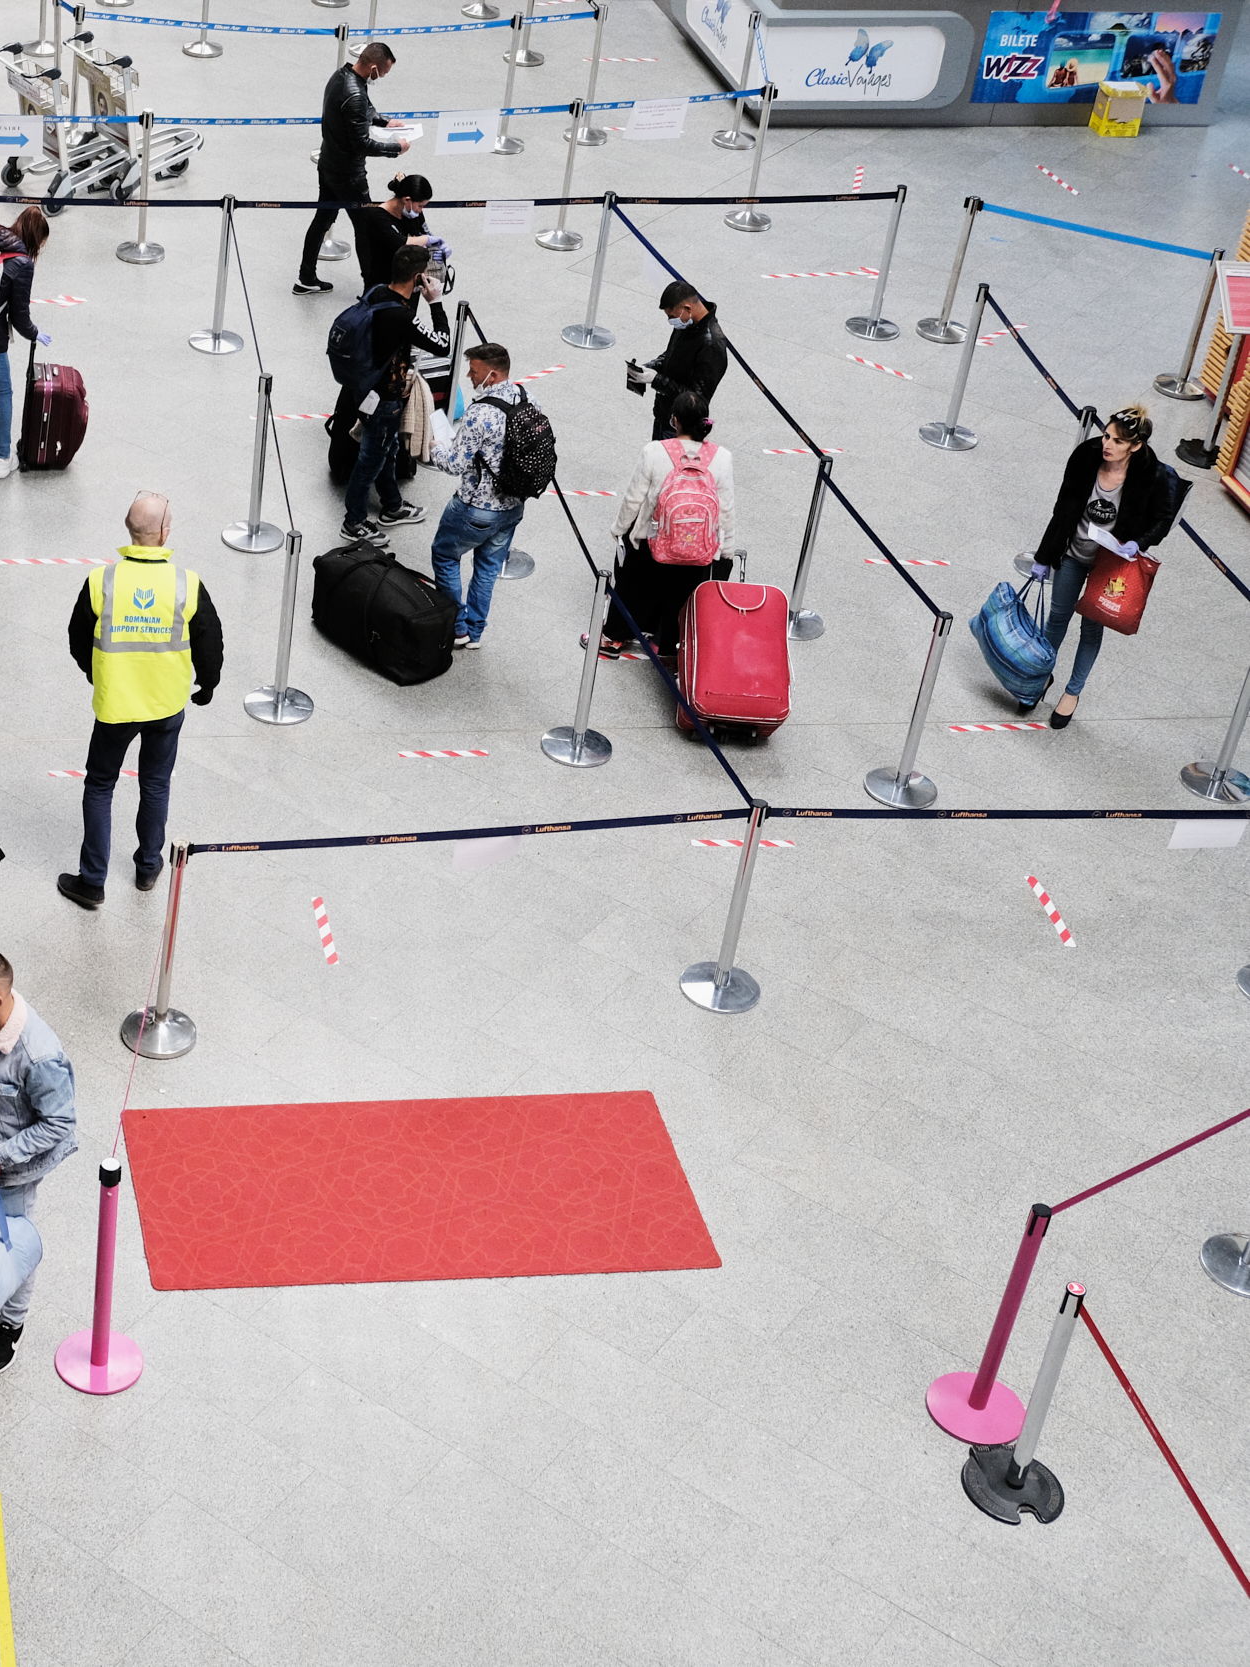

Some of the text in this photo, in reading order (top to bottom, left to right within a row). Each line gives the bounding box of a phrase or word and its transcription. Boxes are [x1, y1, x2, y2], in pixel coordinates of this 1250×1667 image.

[1000, 34, 1038, 47] BILETE
[124, 615, 161, 624] ROMANIAN
[109, 625, 173, 634] AIRPORT SERVICES
[687, 813, 722, 821] Lufthansa
[535, 824, 571, 833] Lufthansa
[380, 835, 417, 843] Lufthansa
[221, 844, 260, 852] Lufthansa
